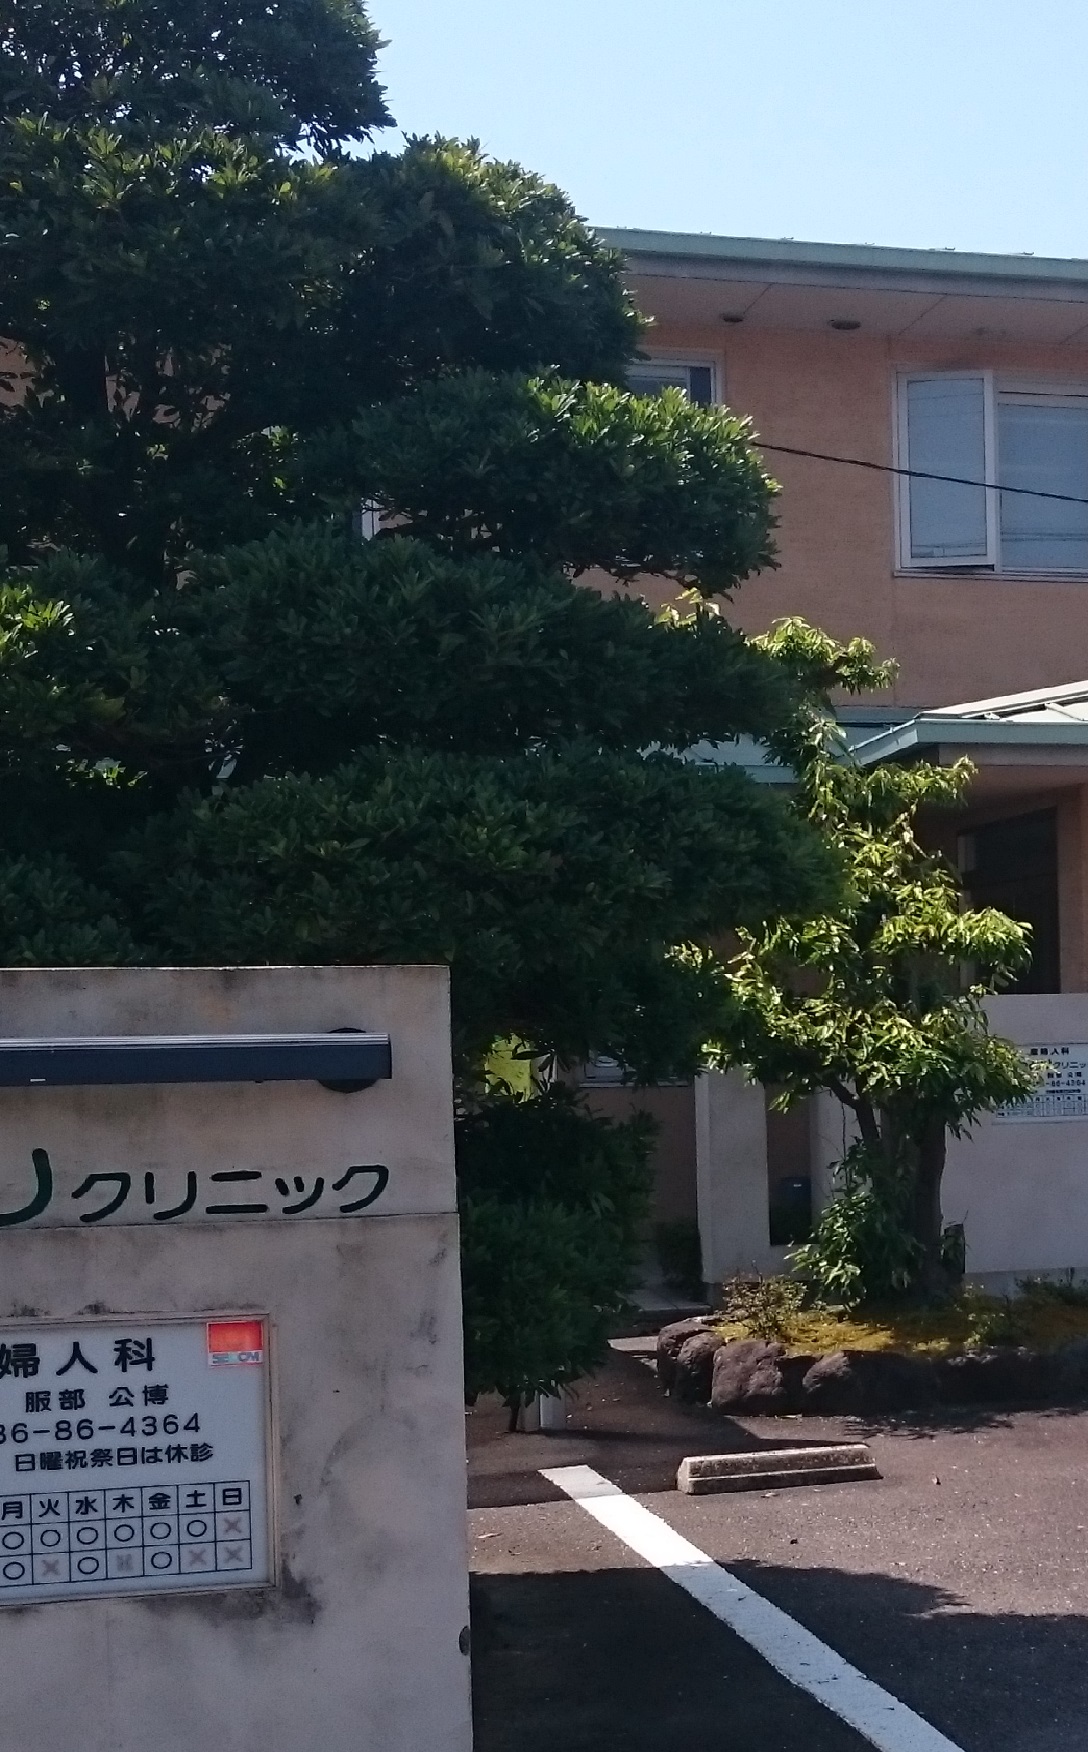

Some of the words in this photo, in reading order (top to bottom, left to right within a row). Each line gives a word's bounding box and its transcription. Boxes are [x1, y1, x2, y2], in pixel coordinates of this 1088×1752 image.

[25, 1388, 86, 1413] 服部
[108, 1383, 169, 1407] 公博
[15, 1442, 214, 1472] 日曜祝祭日は休診
[1, 1500, 24, 1521] 月
[38, 1498, 61, 1518] 火
[75, 1496, 99, 1516] 水
[112, 1493, 135, 1513] 木
[148, 1492, 171, 1511] 金
[185, 1489, 207, 1509] 土
[222, 1487, 242, 1506] 日
